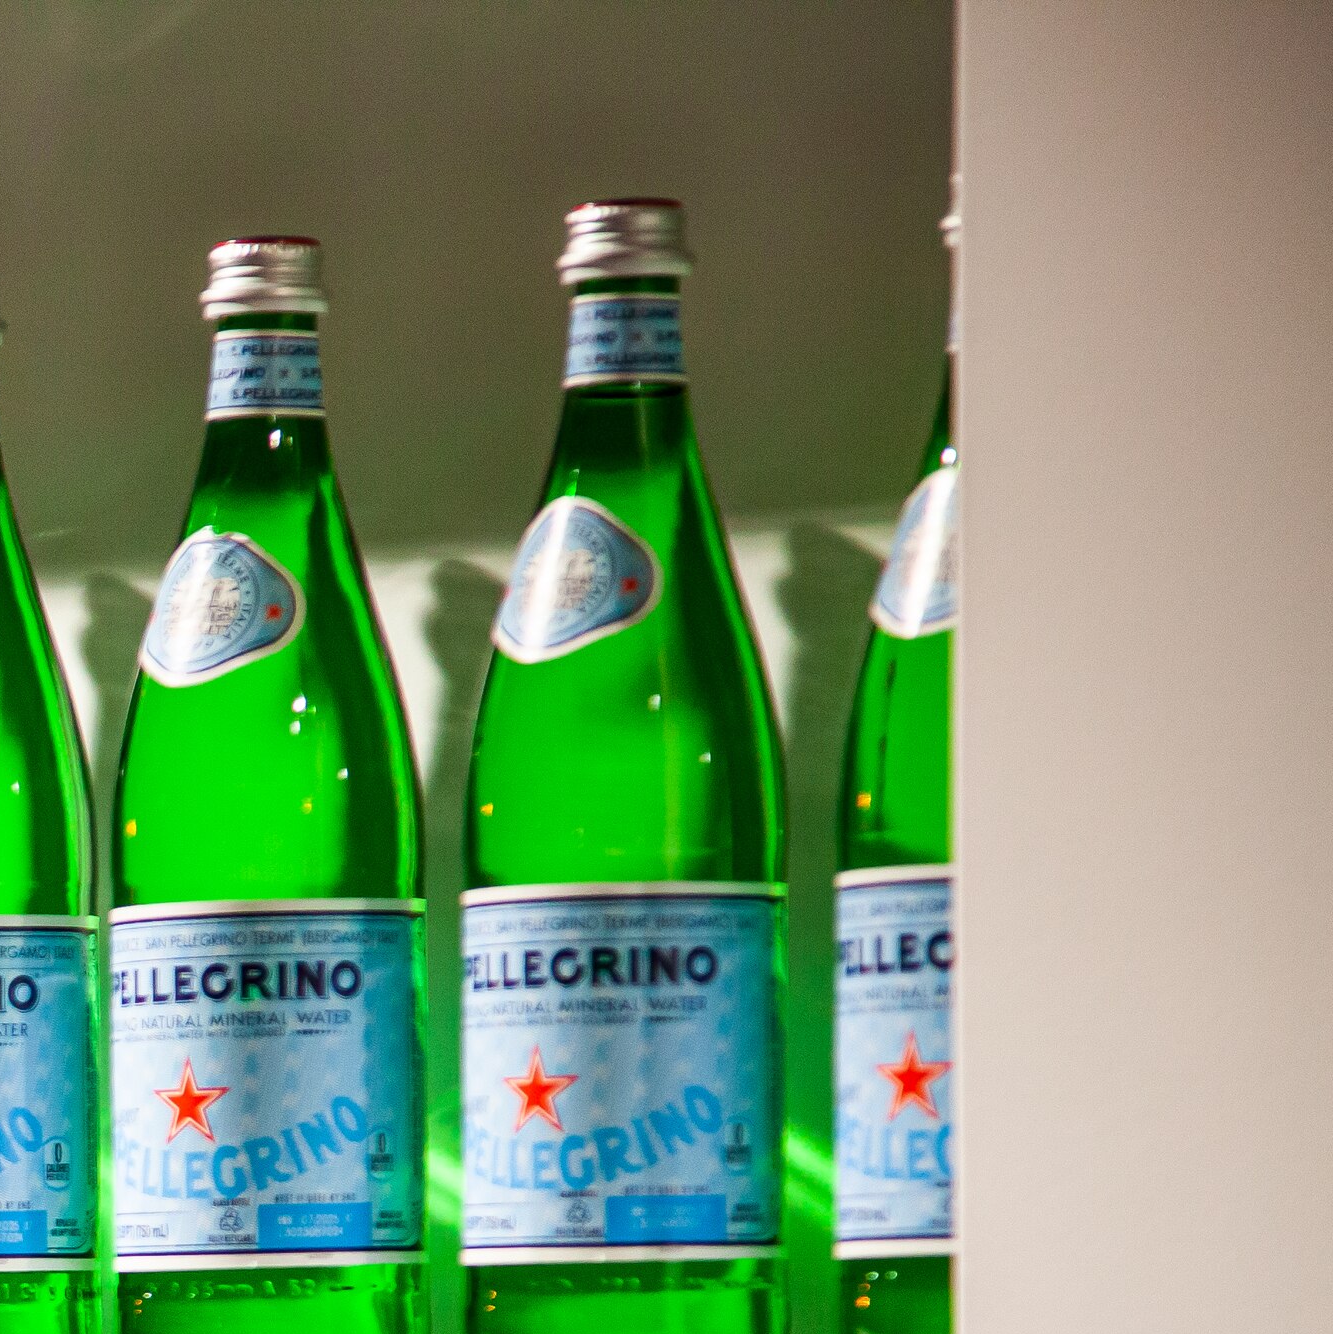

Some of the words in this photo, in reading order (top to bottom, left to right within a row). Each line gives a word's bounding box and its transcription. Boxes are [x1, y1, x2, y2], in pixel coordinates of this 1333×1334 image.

[141, 1015, 202, 1030] NATURAL
[209, 1011, 287, 1027] MINERAL
[295, 1009, 352, 1025] WATER
